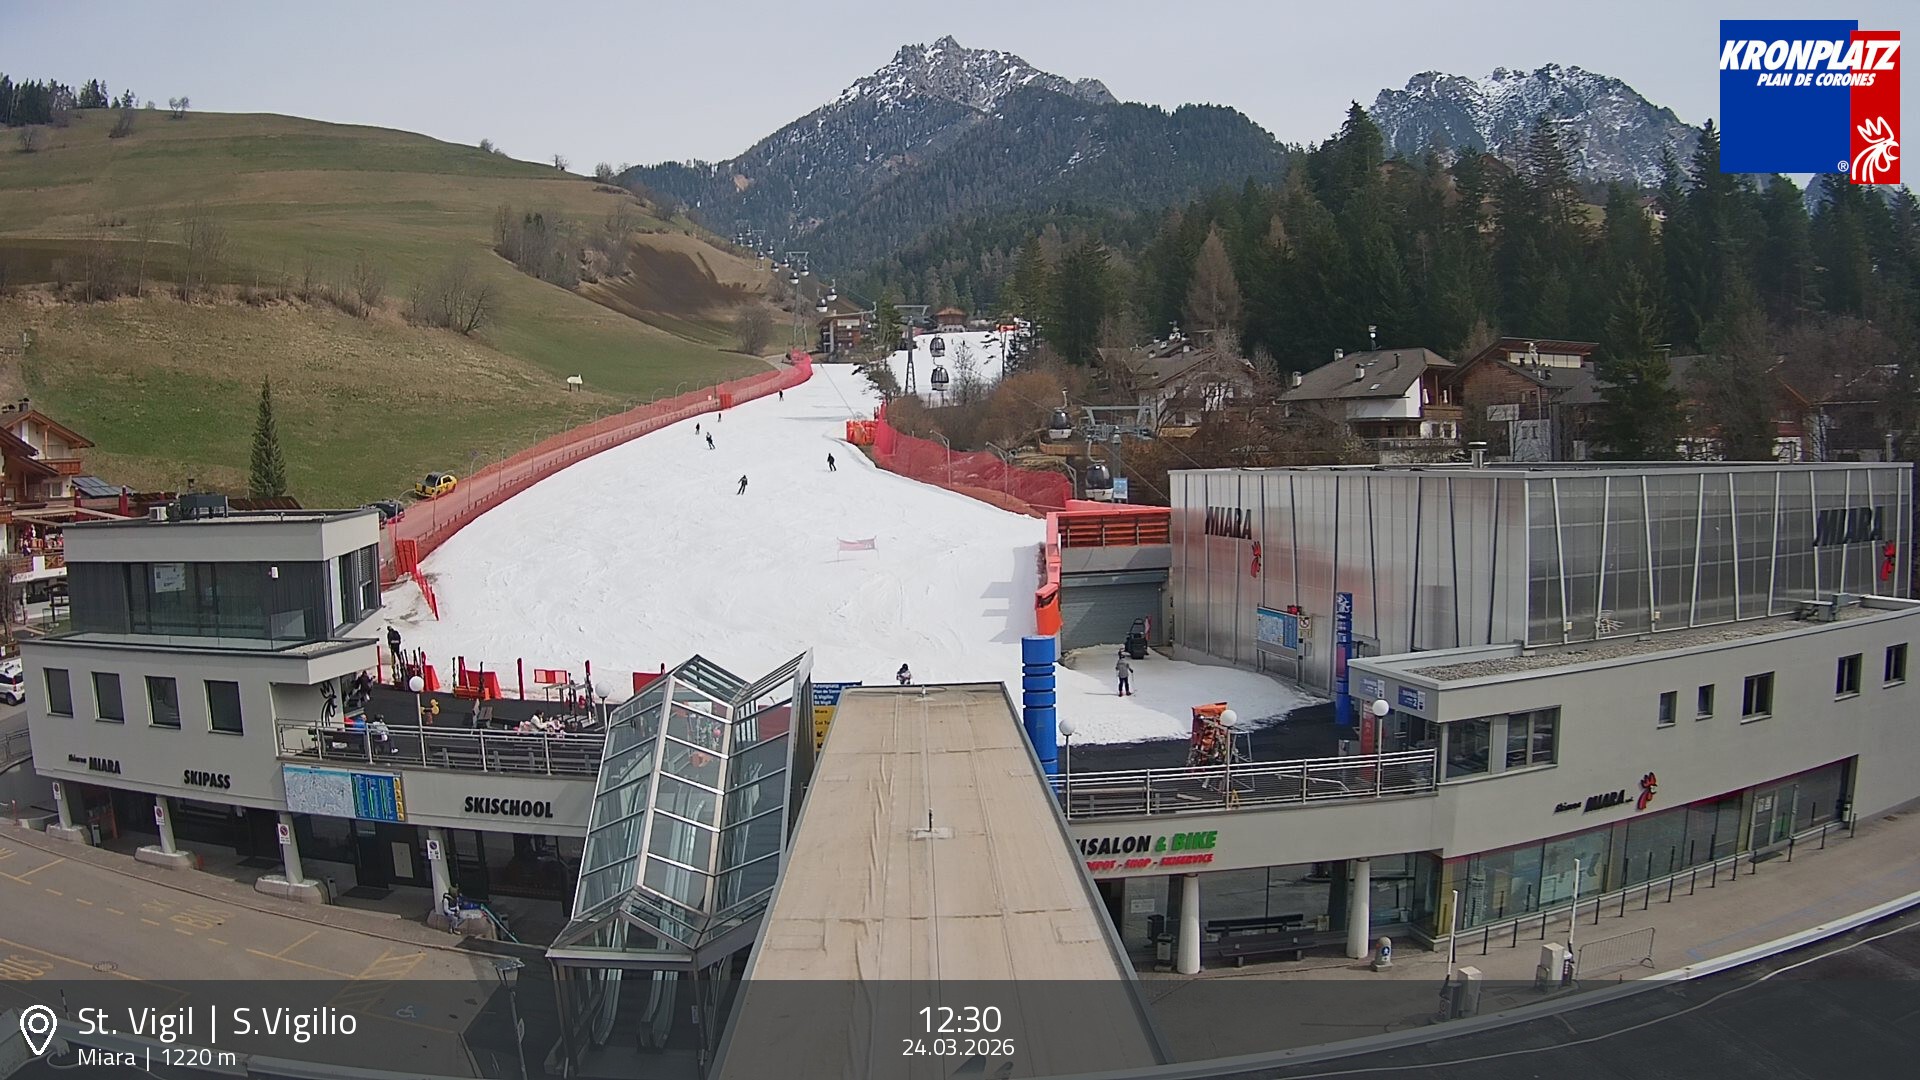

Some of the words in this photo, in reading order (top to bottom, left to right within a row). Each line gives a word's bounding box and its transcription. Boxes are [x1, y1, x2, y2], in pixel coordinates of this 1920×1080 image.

[1205, 506, 1252, 540] MIARA
[1813, 506, 1883, 548] MIARA
[89, 757, 121, 774] MIARA
[183, 769, 231, 789] SKIPASS
[464, 796, 554, 818] SKISCHOOL
[1583, 789, 1626, 813] MIARA
[1075, 835, 1152, 856] ISALON
[1155, 836, 1167, 852] &
[1171, 831, 1217, 851] BIKE
[1124, 858, 1152, 869] SHOP
